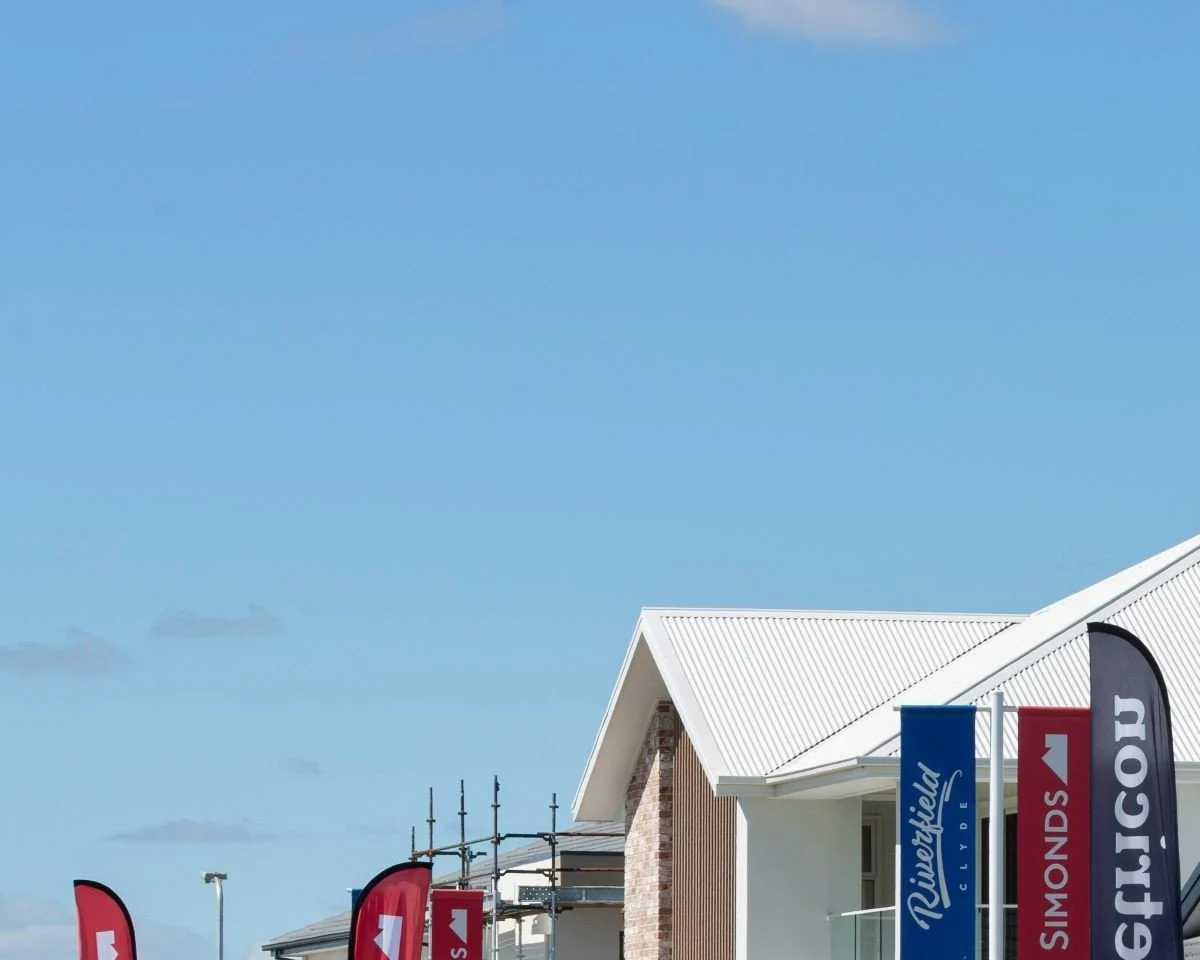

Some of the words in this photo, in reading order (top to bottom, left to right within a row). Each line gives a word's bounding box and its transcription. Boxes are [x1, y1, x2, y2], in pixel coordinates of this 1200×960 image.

[906, 760, 953, 931] Riverfield
[959, 801, 969, 892] CLYDE
[1040, 789, 1070, 951] SIMONDS
